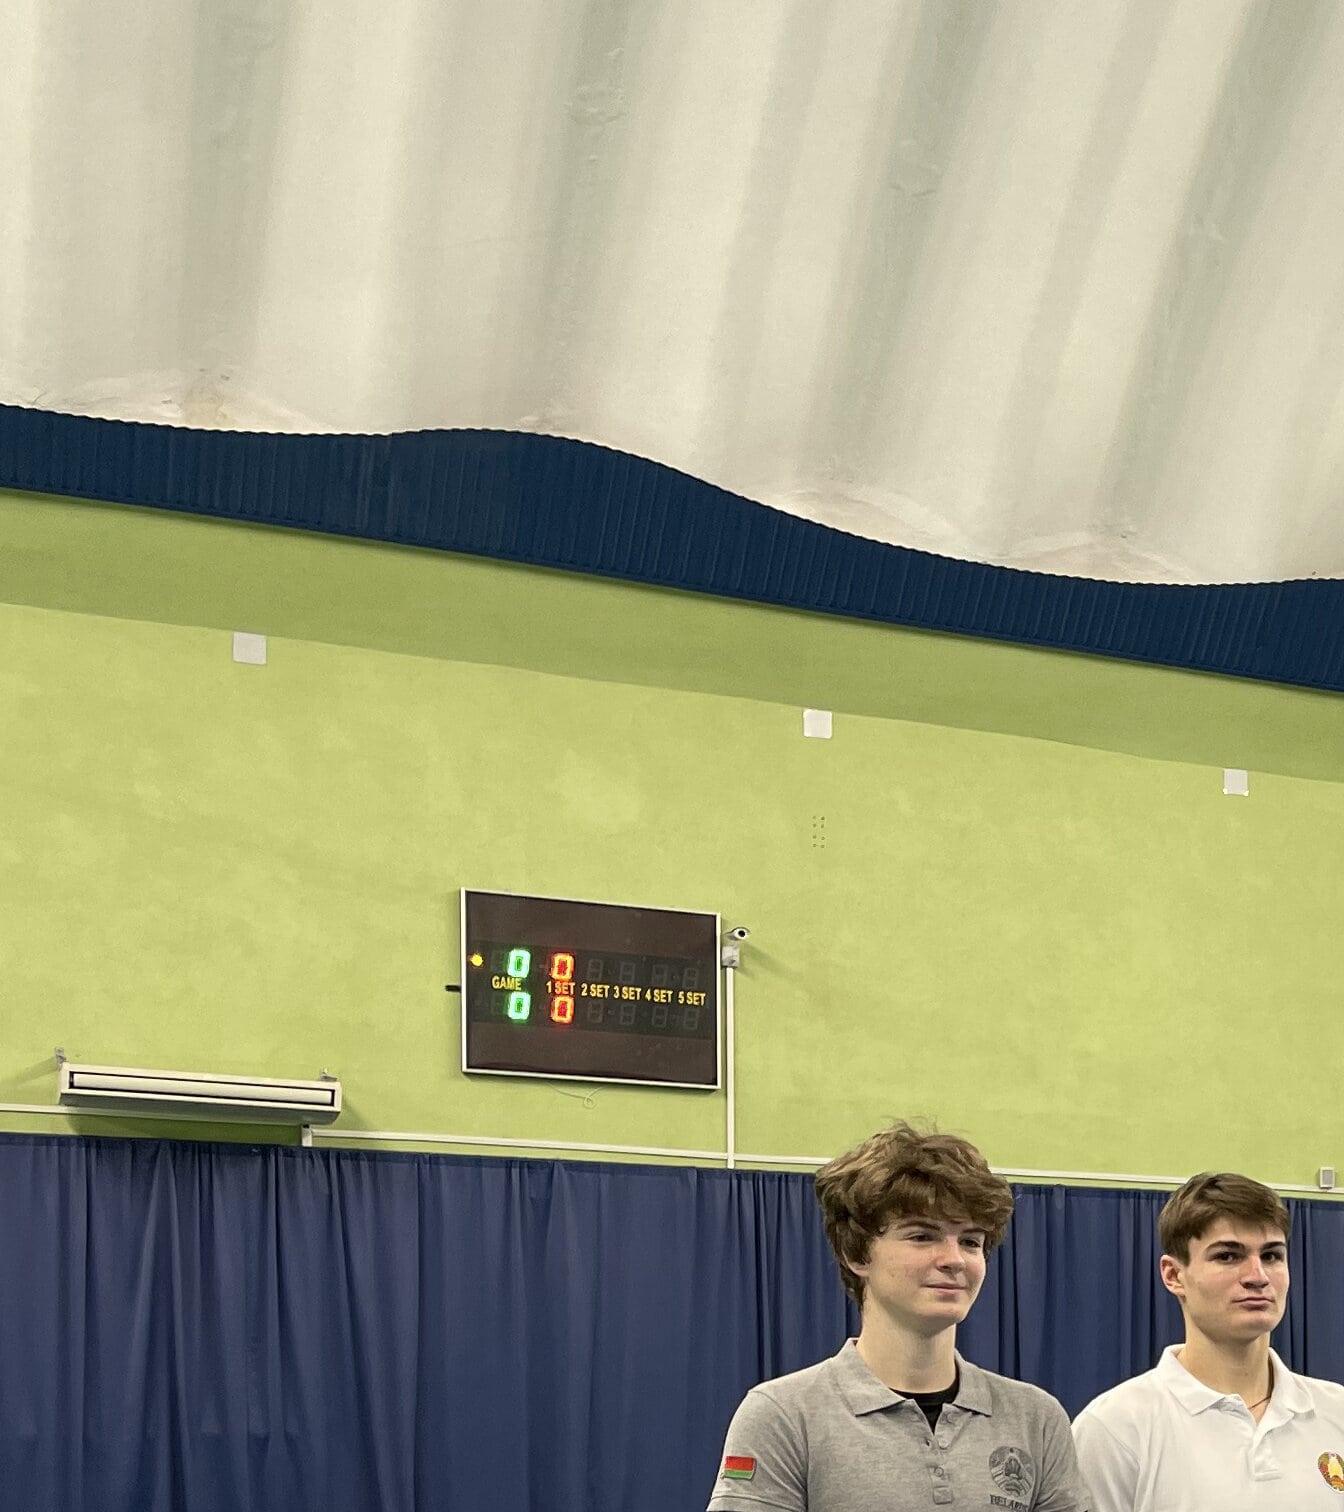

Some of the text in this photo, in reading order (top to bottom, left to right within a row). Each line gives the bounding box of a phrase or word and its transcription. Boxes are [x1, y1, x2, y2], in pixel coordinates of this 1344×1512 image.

[508, 949, 575, 981] 0 0
[491, 976, 522, 992] GAME
[555, 981, 576, 995] SET
[589, 984, 610, 999] SET
[621, 986, 642, 1000] SET
[653, 988, 674, 1003] SET
[686, 991, 706, 1006] SET
[508, 991, 574, 1023] 0 0
